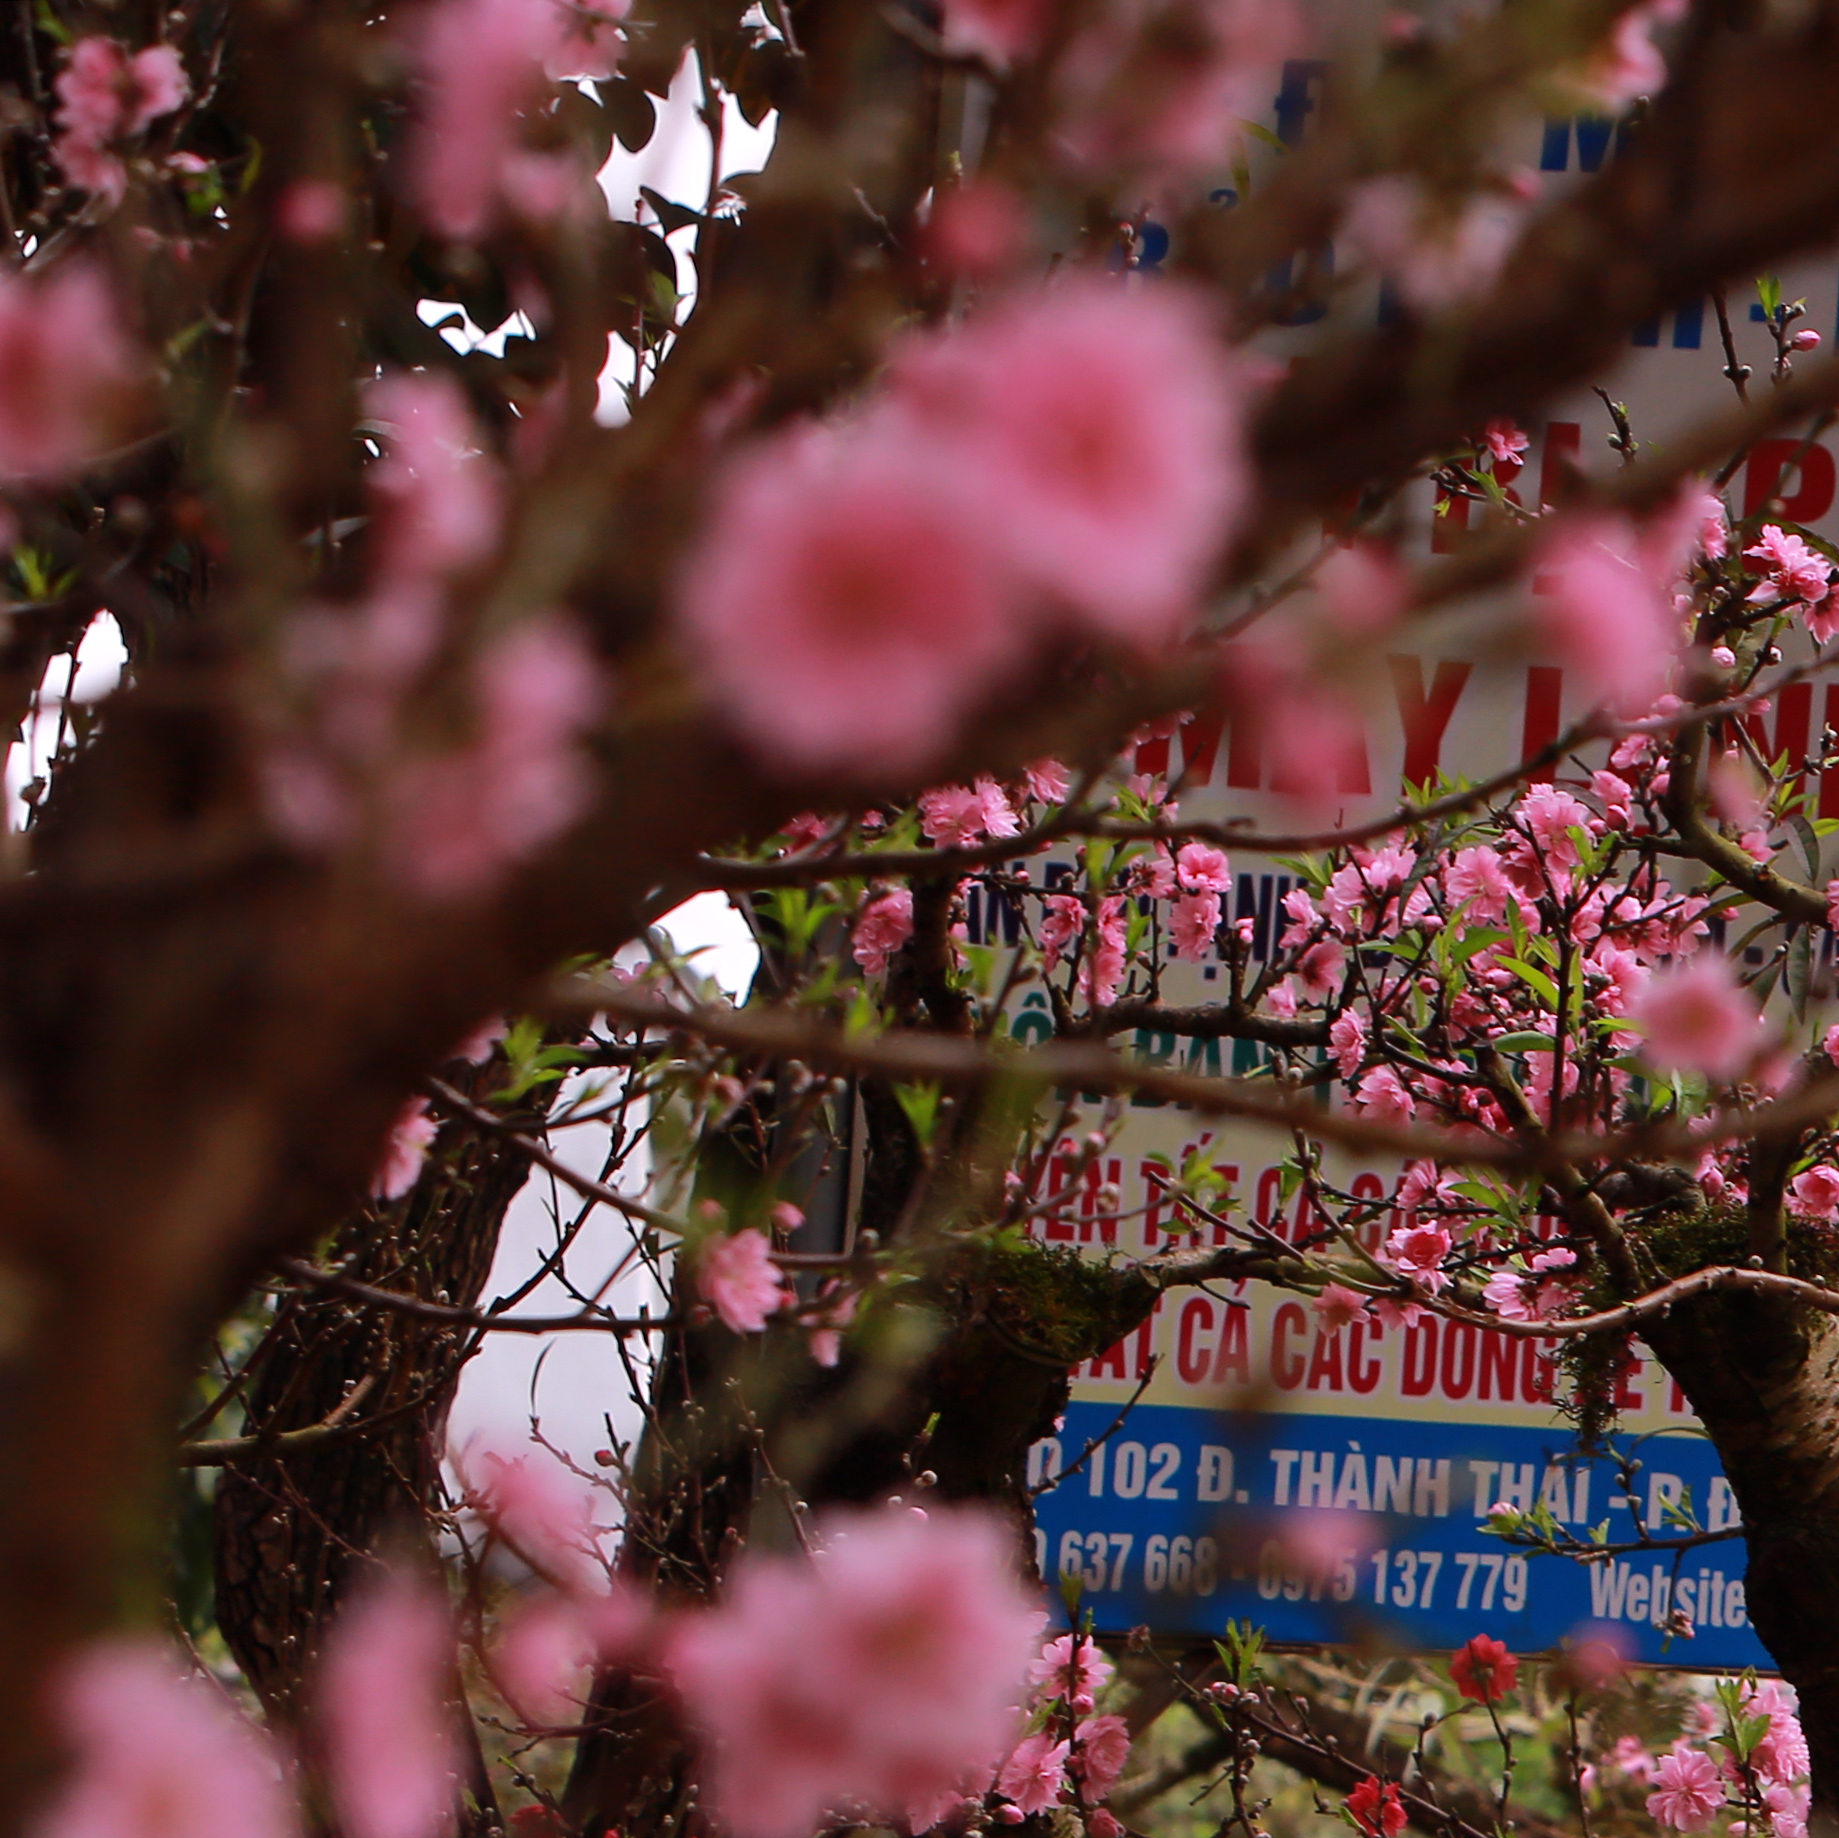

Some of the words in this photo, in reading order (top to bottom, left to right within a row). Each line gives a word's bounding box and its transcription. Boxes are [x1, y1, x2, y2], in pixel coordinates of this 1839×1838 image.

[1134, 652, 1474, 796] MY
[1087, 1439, 1182, 1499] 102
[1196, 1444, 1250, 1504] Đ.
[1270, 1440, 1451, 1518] THÀNH
[1059, 1529, 1134, 1592] 637
[1144, 1533, 1220, 1597] 668
[1371, 1549, 1443, 1611] 137
[1455, 1552, 1529, 1613] 779
[1590, 1561, 1755, 1629] Website
